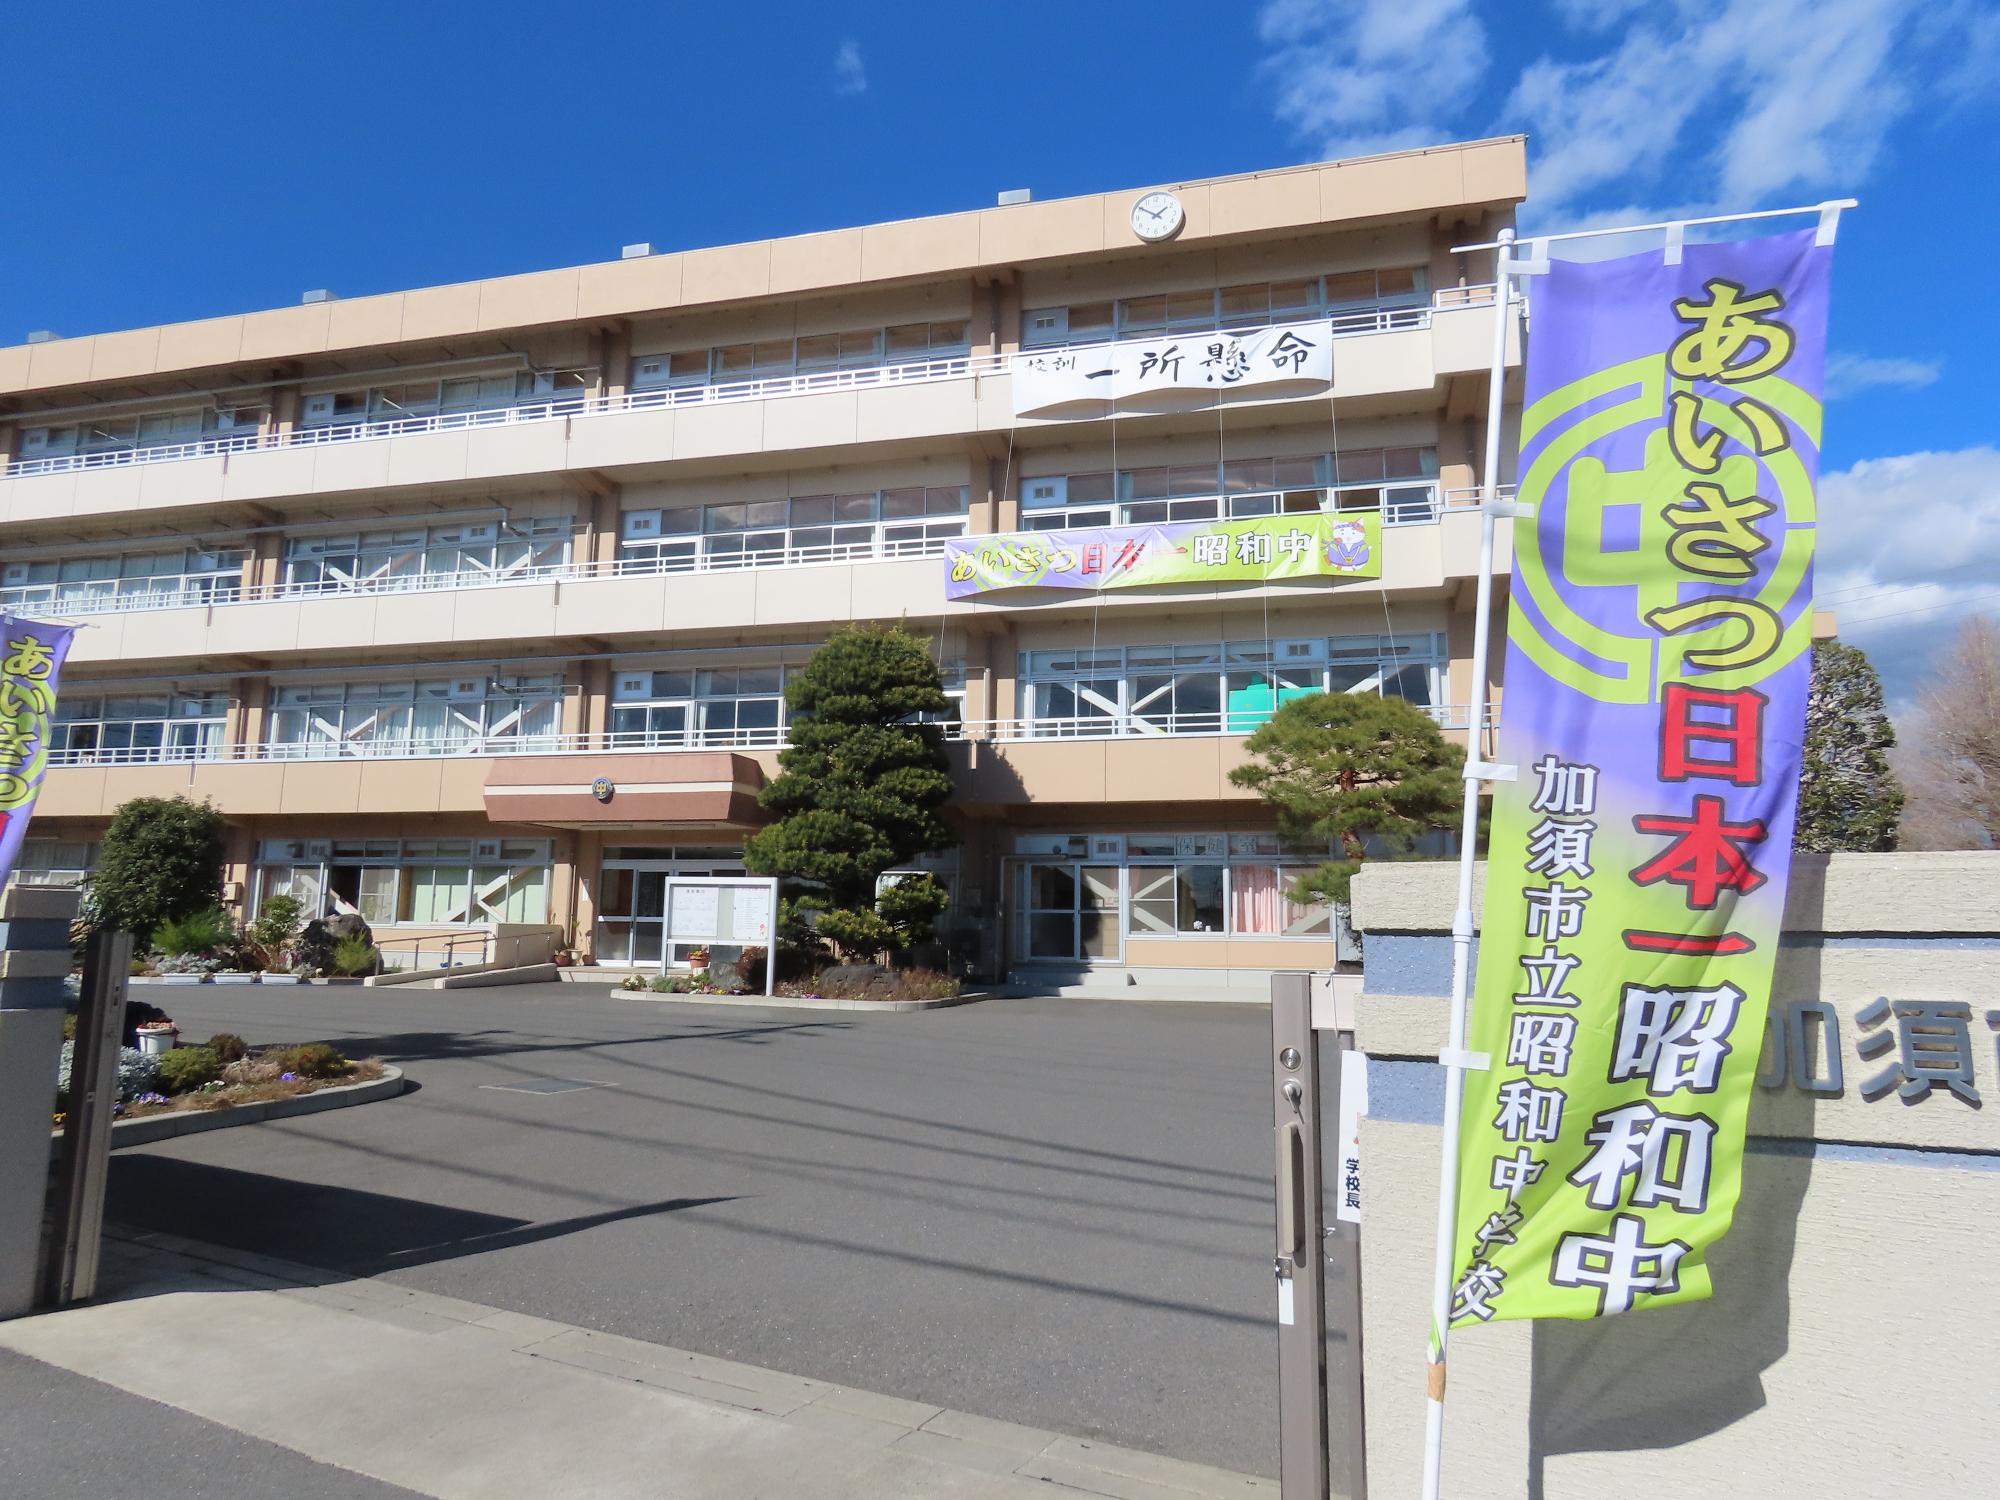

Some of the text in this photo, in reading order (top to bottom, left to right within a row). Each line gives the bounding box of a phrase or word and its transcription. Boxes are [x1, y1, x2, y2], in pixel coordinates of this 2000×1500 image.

[1085, 331, 1318, 383] 一所懸命
[949, 528, 1313, 583] あいさつ日本一昭和中
[1550, 276, 1796, 1317] あいさつ日本一昭和中
